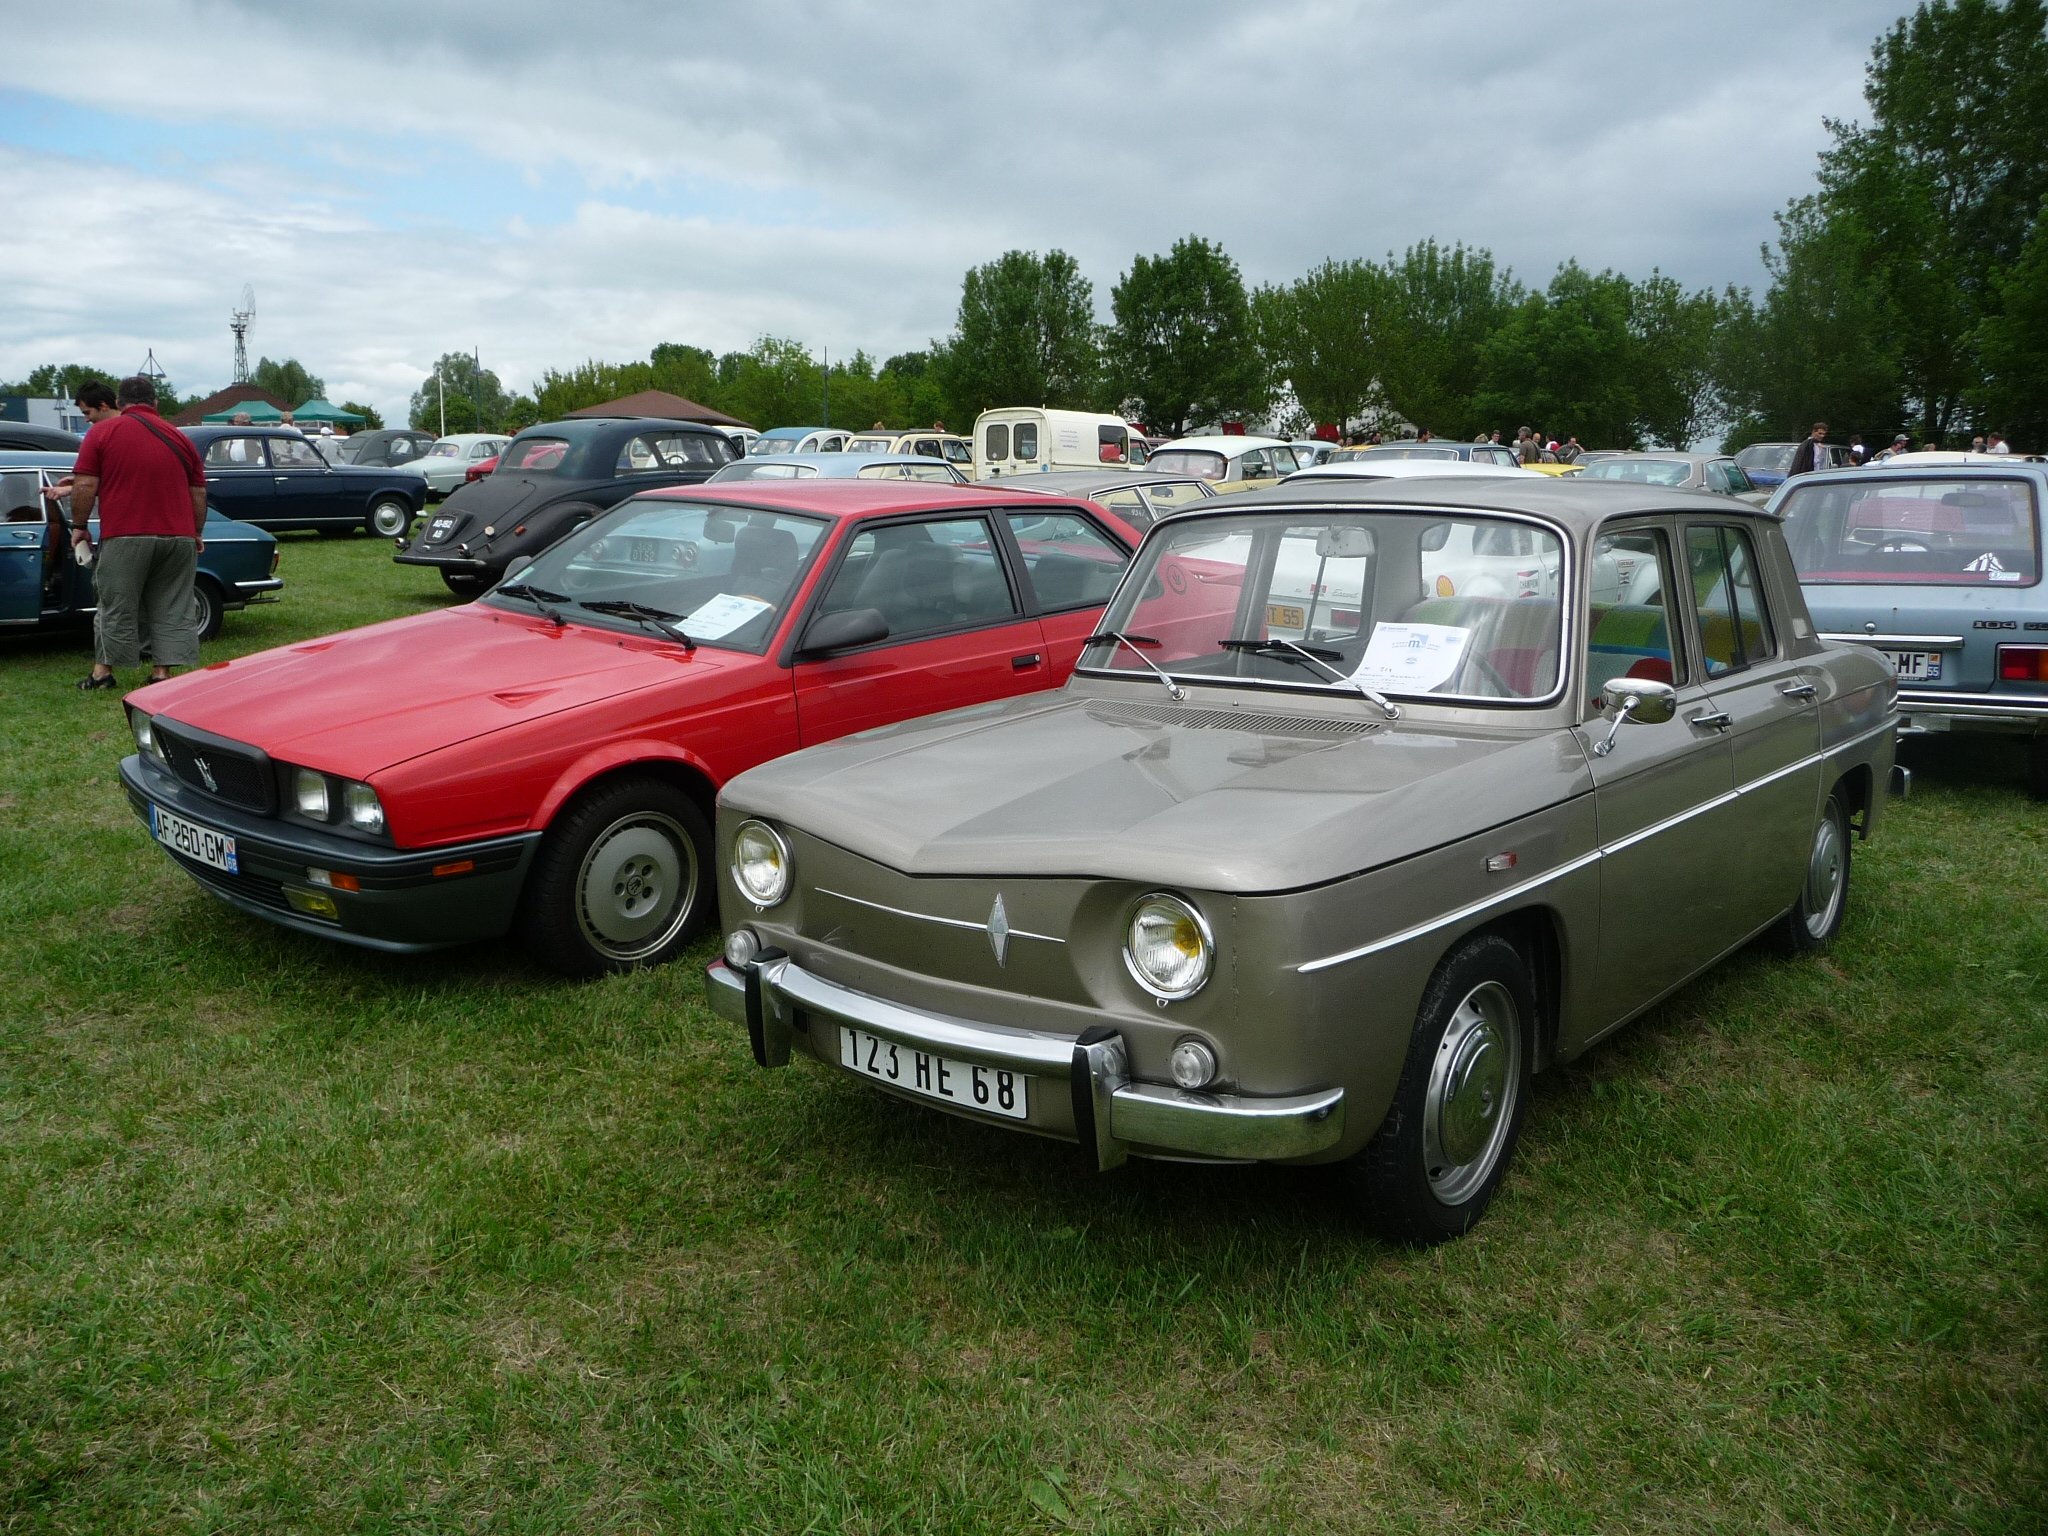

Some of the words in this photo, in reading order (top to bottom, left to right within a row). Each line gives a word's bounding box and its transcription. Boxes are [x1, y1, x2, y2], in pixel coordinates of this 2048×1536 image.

[1283, 608, 1300, 625] 55
[1974, 620, 2017, 630] 104
[1928, 665, 1940, 677] 55
[848, 1028, 899, 1080] 123
[915, 1051, 954, 1097] HE
[971, 1065, 1015, 1111] 68
